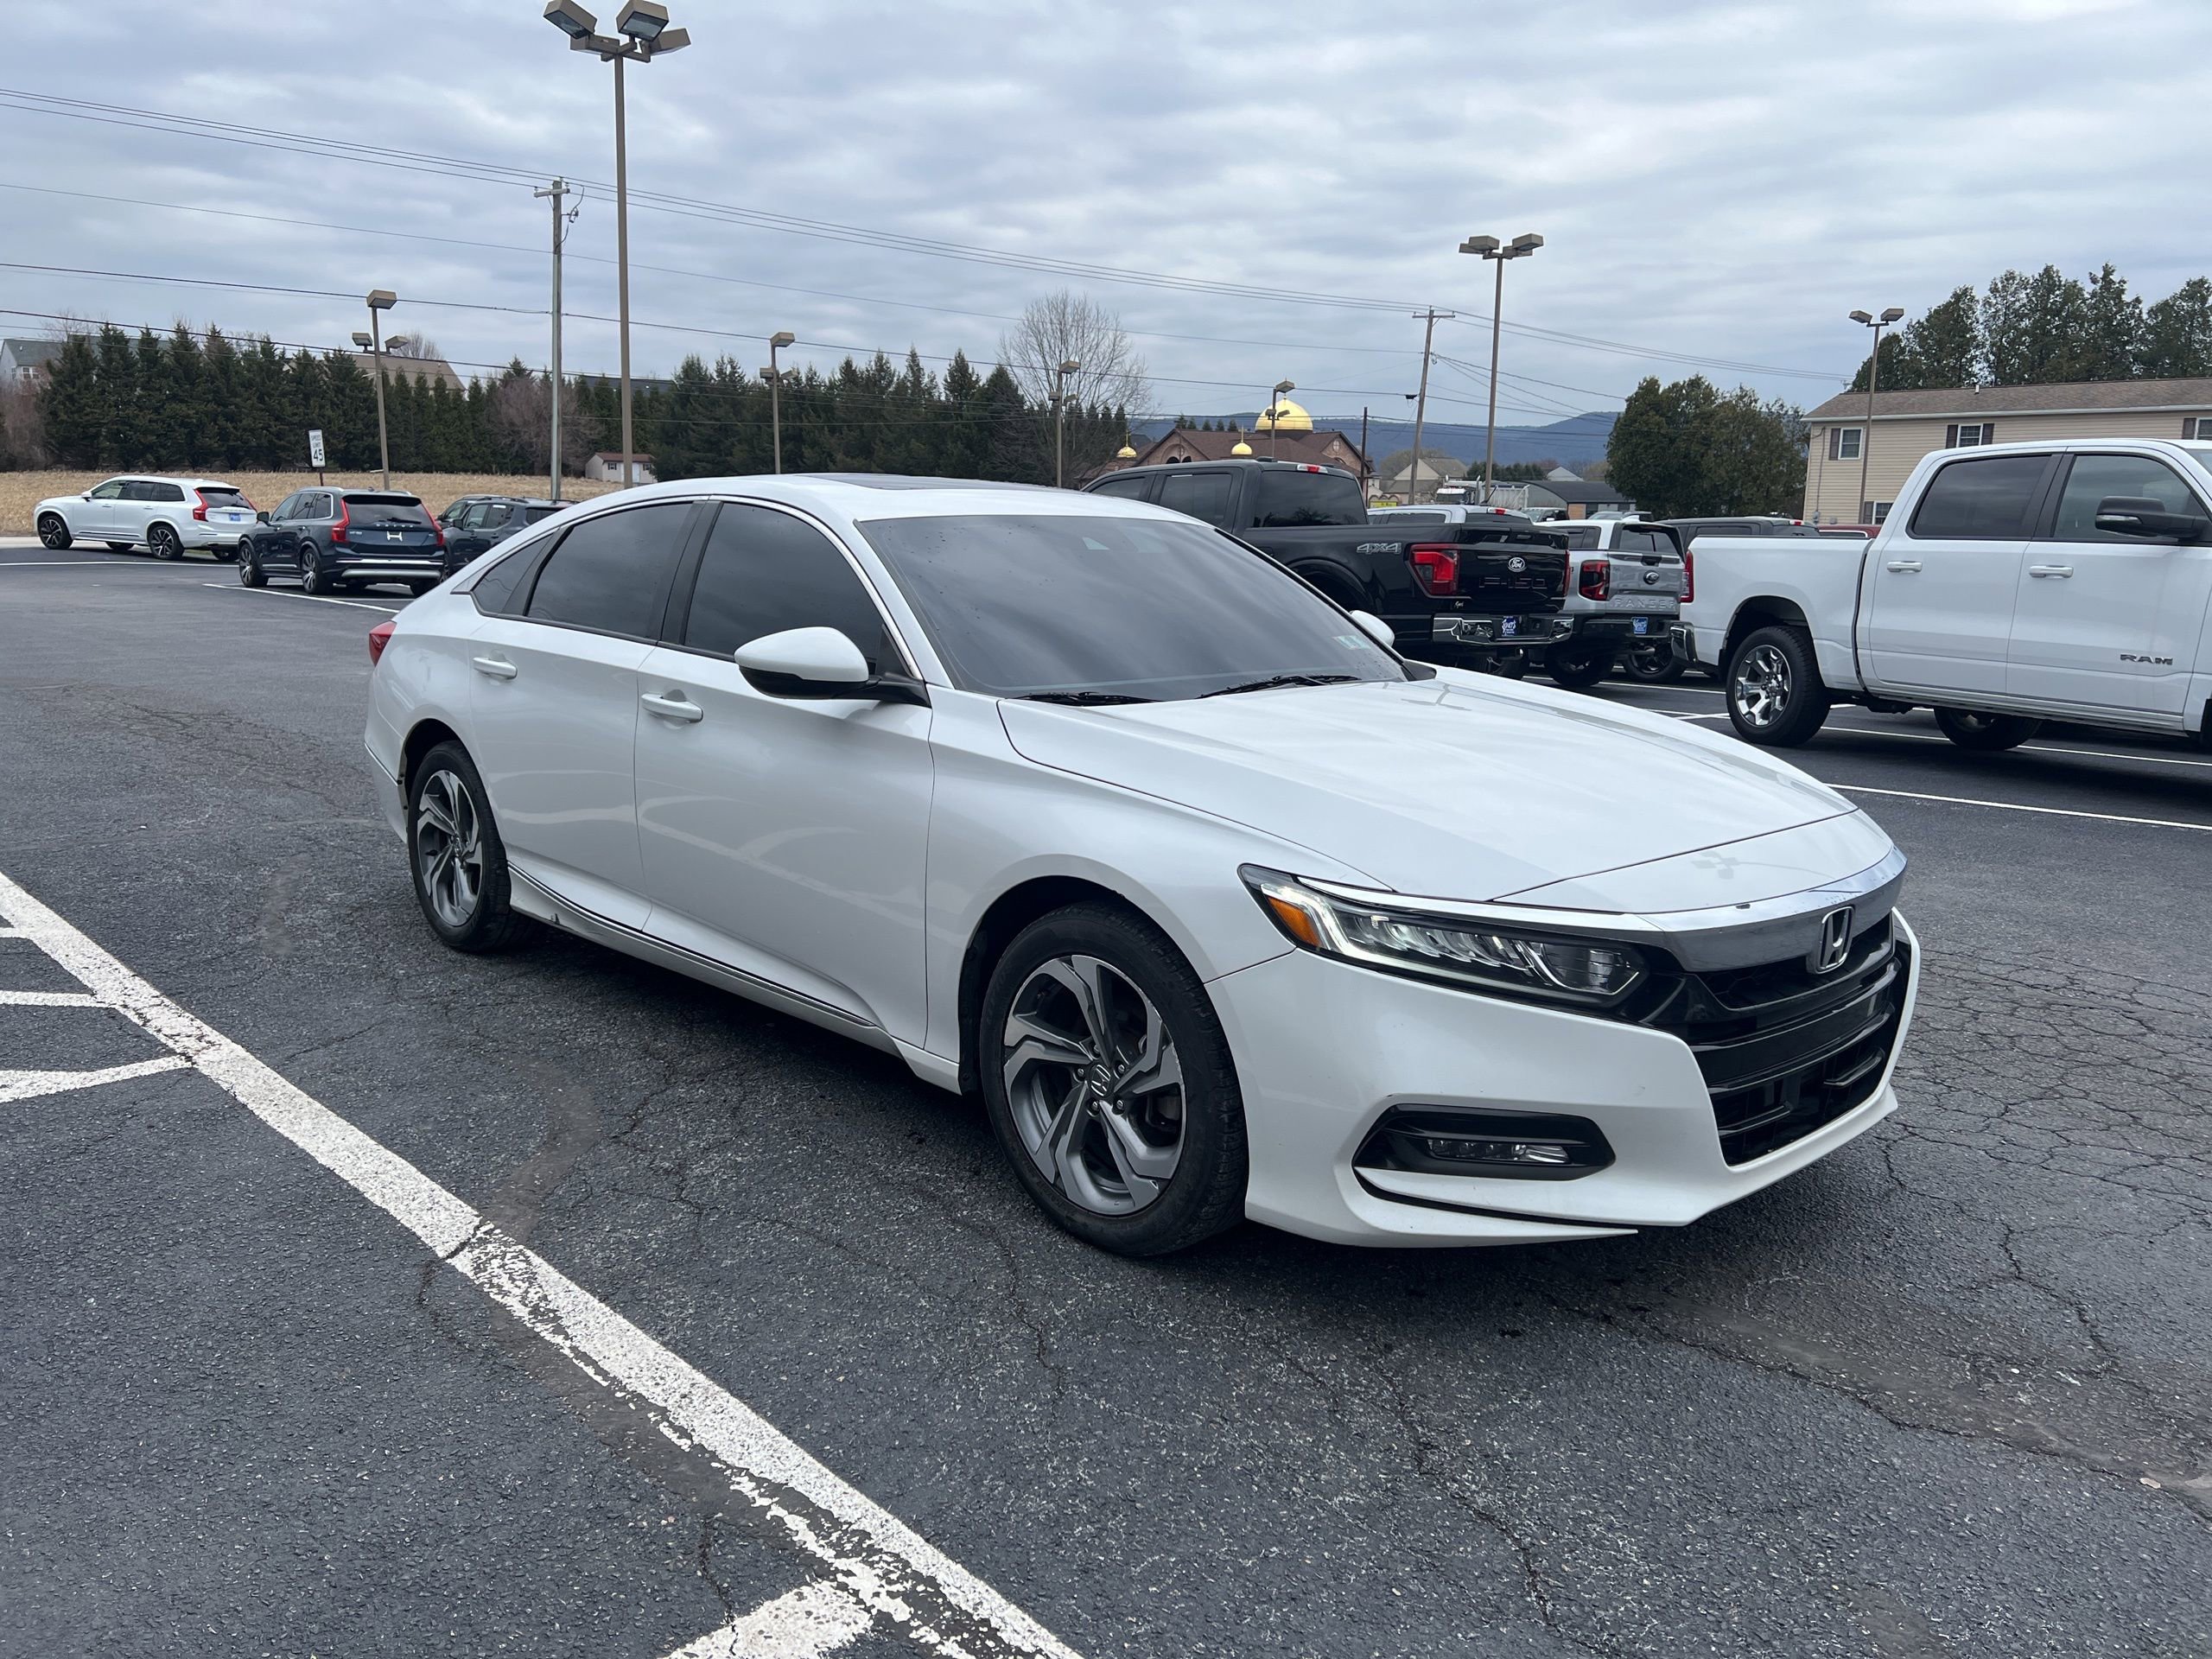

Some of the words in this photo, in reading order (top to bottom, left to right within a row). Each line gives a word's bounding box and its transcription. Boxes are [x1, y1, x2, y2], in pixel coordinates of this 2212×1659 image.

[313, 448, 324, 461] 45
[1614, 597, 1676, 609] RANGER
[2120, 653, 2173, 665] RAM
